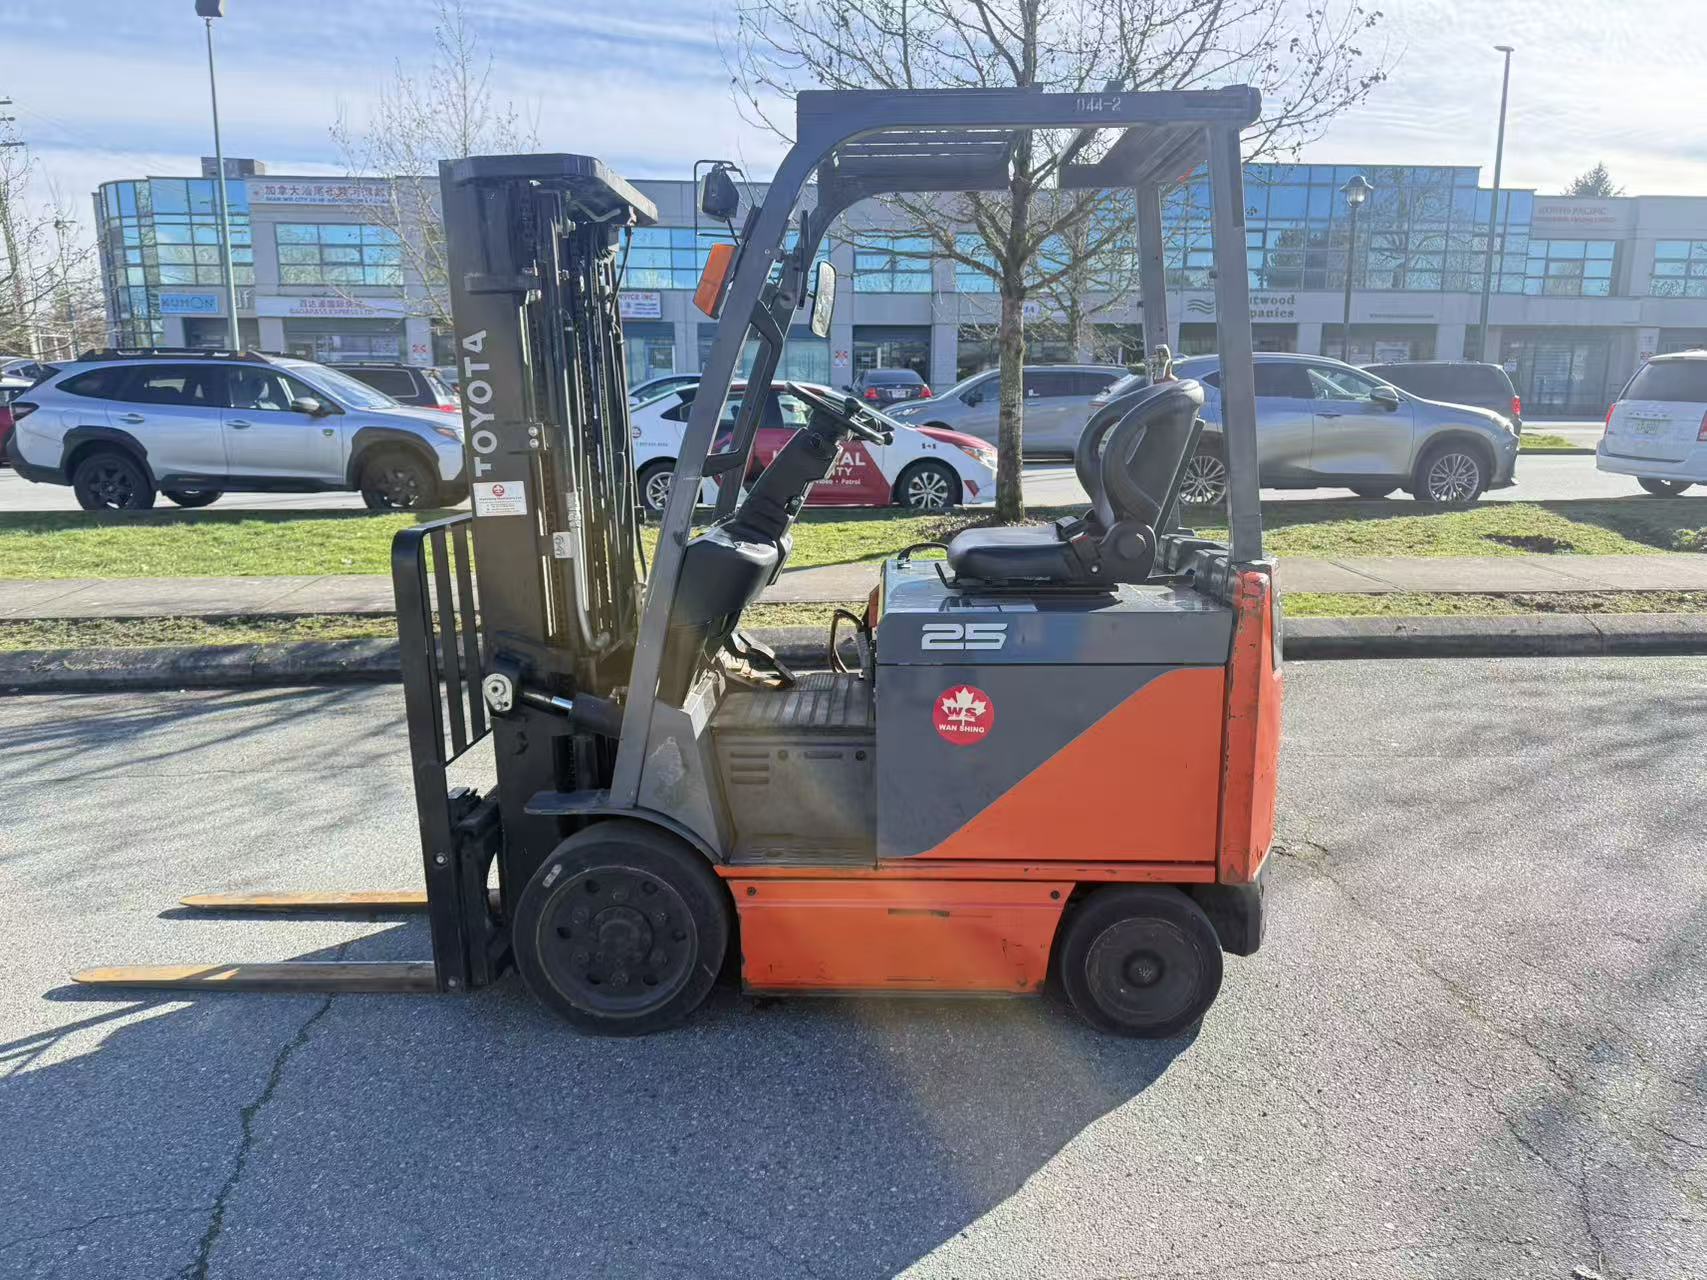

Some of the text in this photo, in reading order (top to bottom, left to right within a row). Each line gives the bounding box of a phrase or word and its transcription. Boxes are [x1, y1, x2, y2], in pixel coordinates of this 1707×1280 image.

[462, 330, 498, 478] TOYOTA
[921, 623, 1008, 650] 25
[939, 723, 957, 732] WAN
